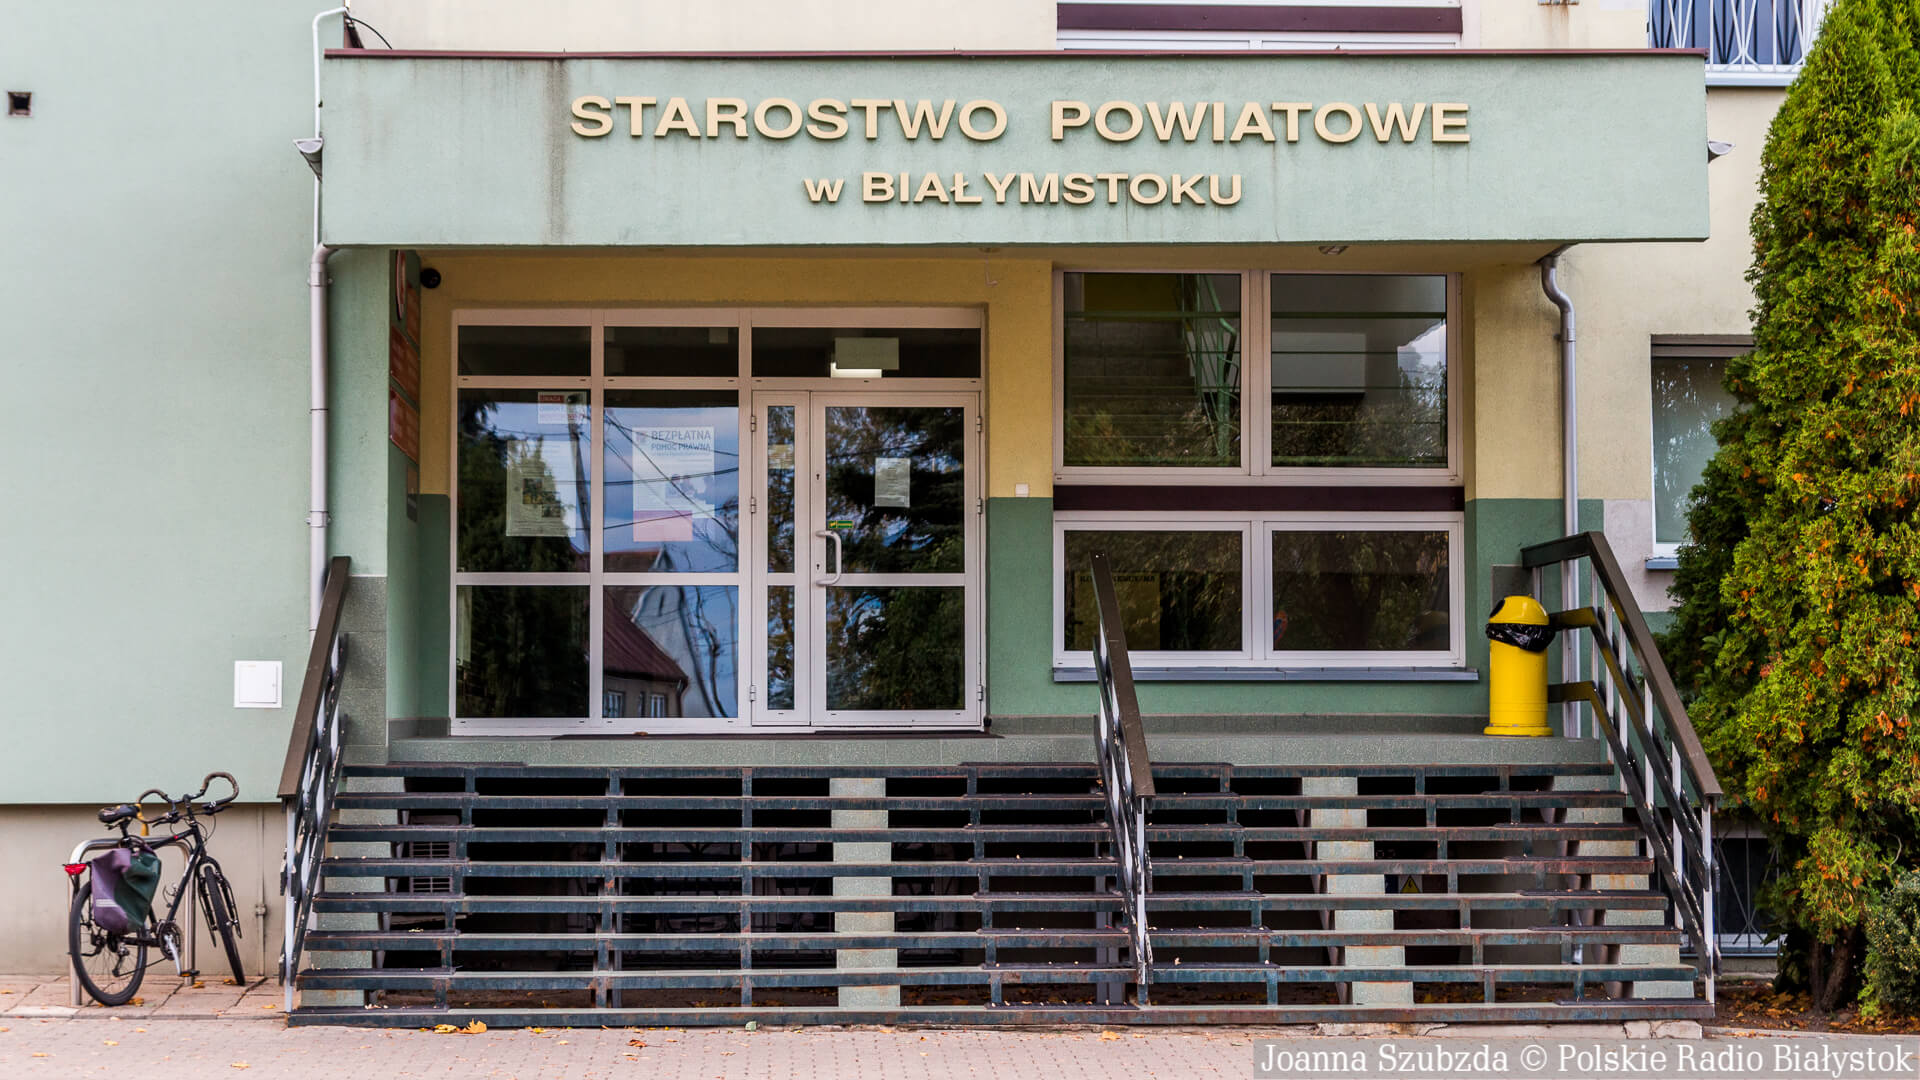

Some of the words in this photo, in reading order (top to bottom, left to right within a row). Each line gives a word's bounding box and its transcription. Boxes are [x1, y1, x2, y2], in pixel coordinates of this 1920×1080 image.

[570, 95, 1008, 140] STAROSTWO
[1050, 100, 1471, 143] POWIATOWE
[804, 178, 845, 203] w
[862, 172, 1242, 206] BIAŁYMSTOKU
[651, 430, 711, 441] BEZPŁATNA
[679, 442, 711, 451] PRAWNA
